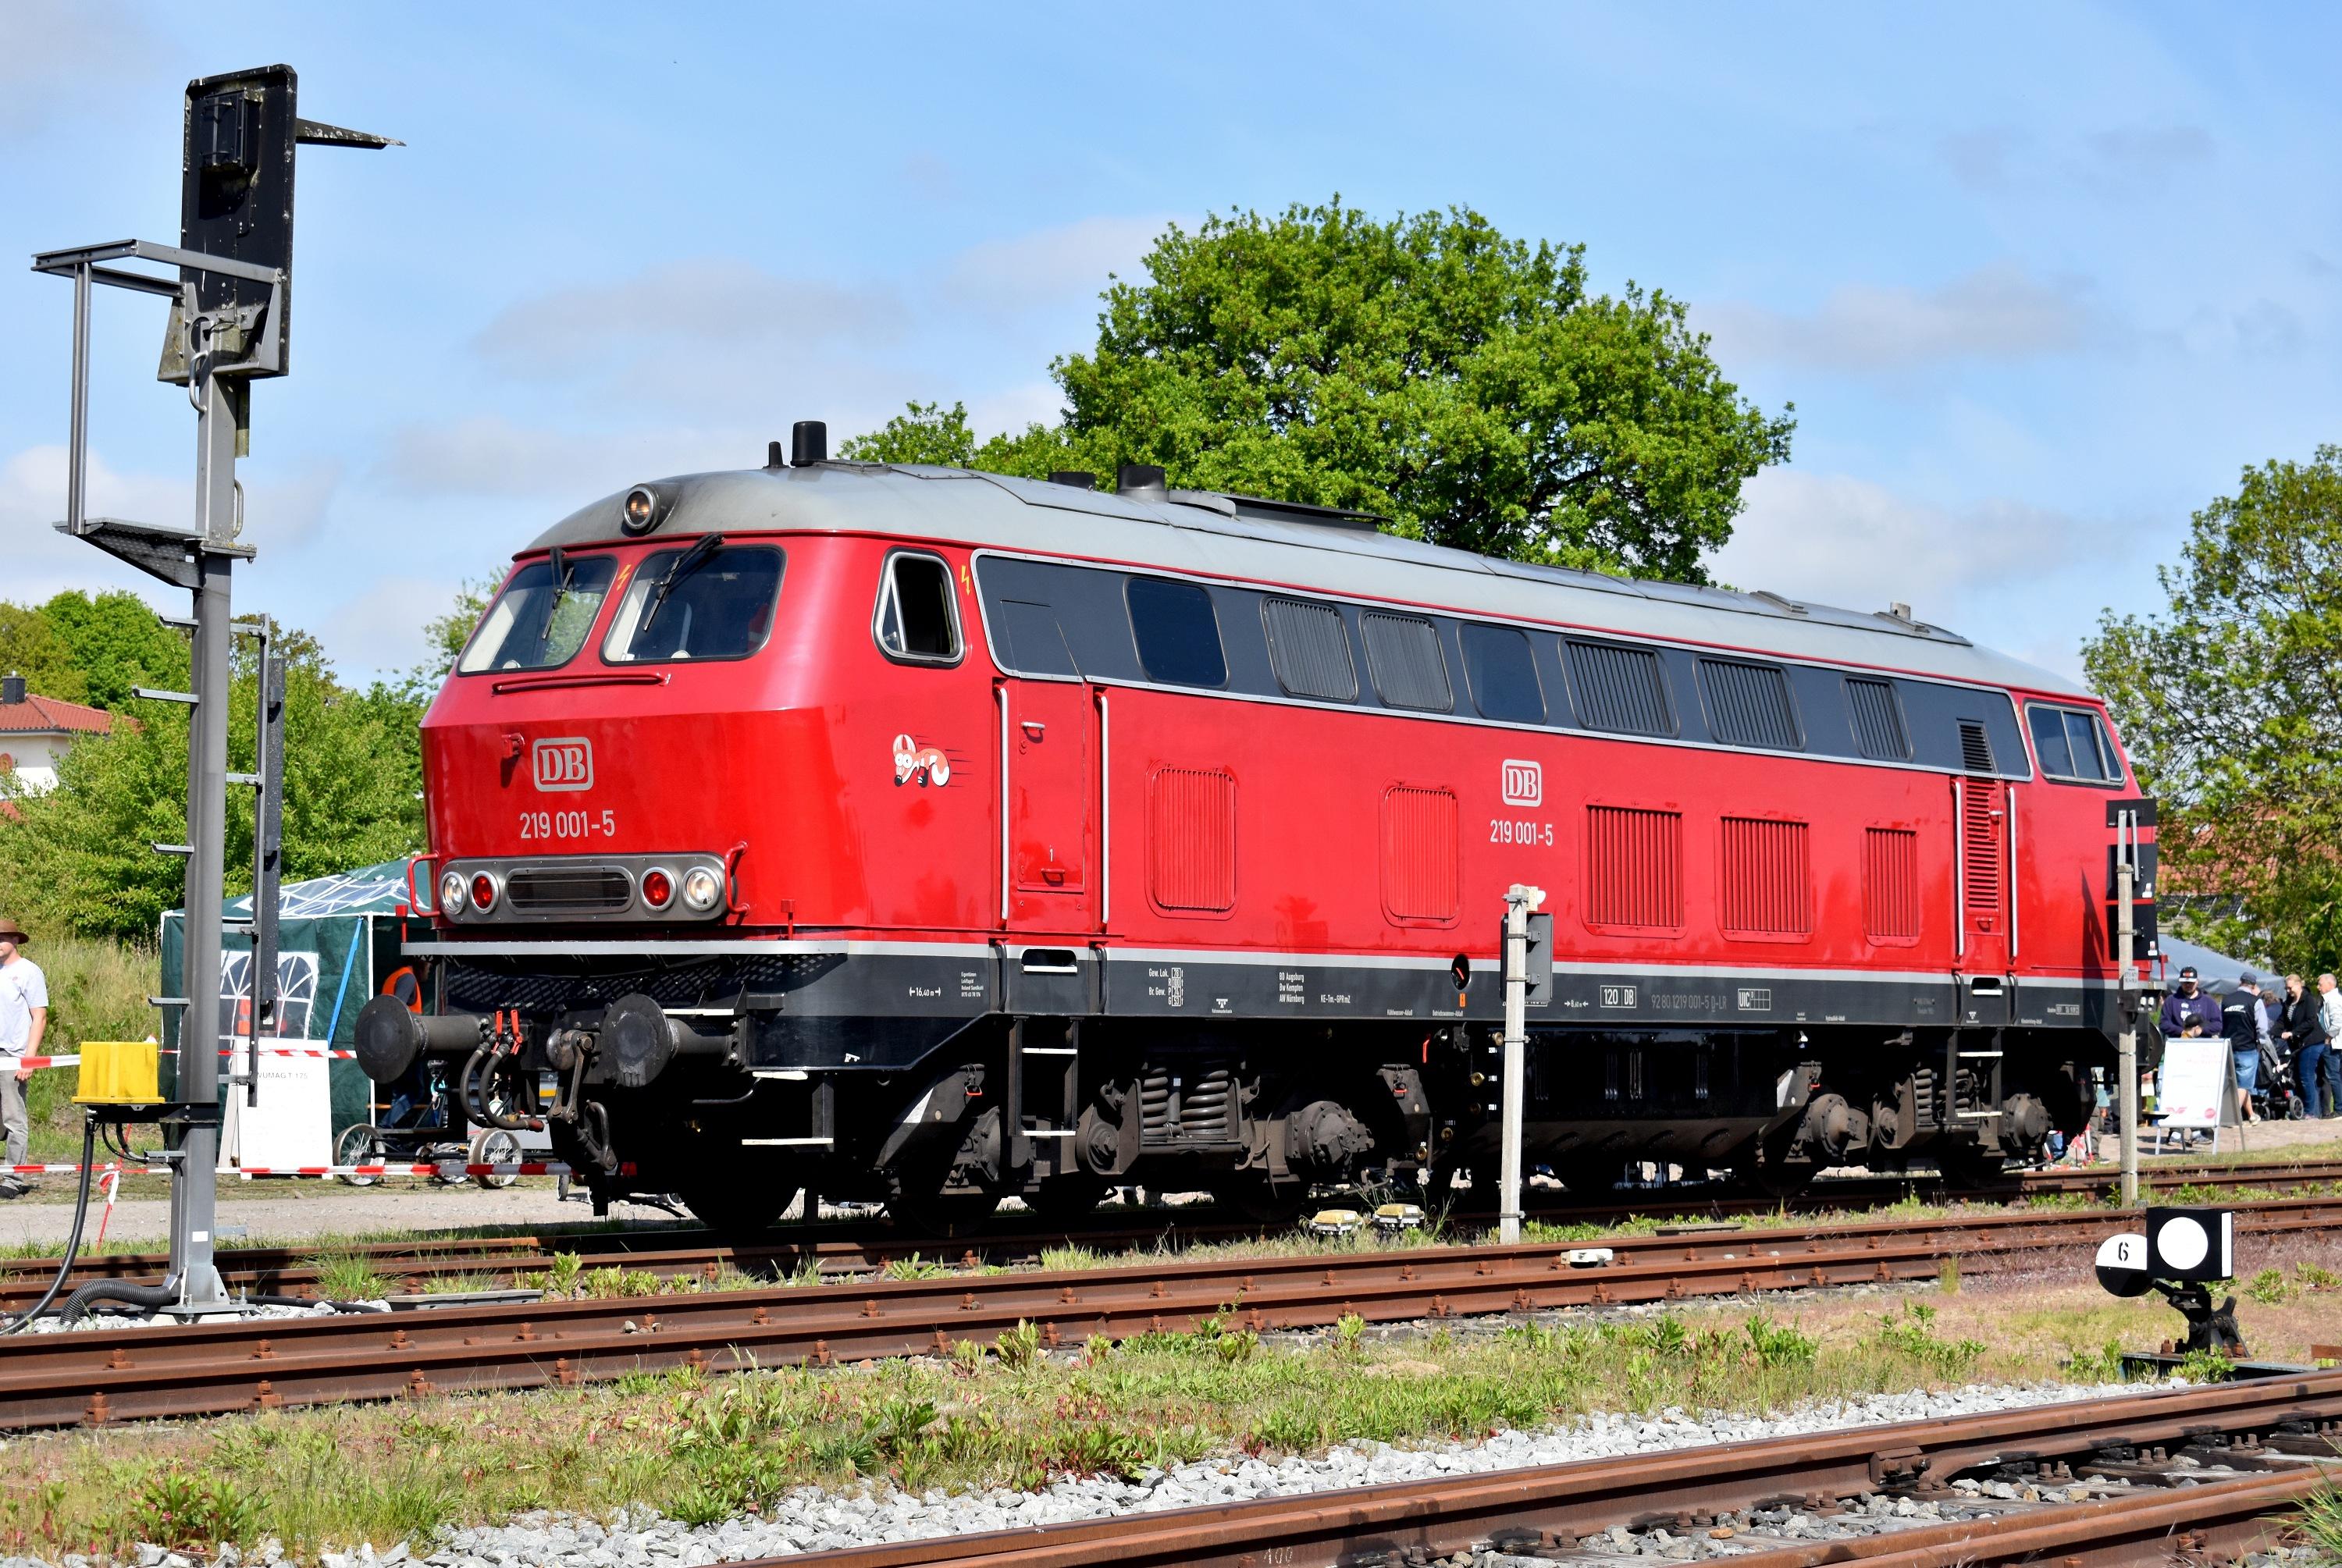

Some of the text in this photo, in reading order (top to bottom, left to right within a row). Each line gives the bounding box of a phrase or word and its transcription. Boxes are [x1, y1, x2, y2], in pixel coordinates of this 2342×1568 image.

[539, 747, 586, 782] DB
[1506, 768, 1537, 798] DB
[519, 809, 615, 839] 219 001-5
[1490, 819, 1554, 847] 219 001-5
[1286, 972, 1304, 983] Augsburg
[1168, 987, 1172, 996] P
[1286, 983, 1304, 994] Kempten
[1286, 994, 1304, 1004] Nürnberg
[1603, 989, 1634, 1005] 120 DB
[1651, 994, 1660, 1008] 92
[1661, 994, 1671, 1008] 80
[1672, 994, 1687, 1009] 1219
[1689, 995, 1710, 1009] 001-5
[1739, 991, 1750, 1008] UIC
[2118, 1242, 2129, 1261] 6
